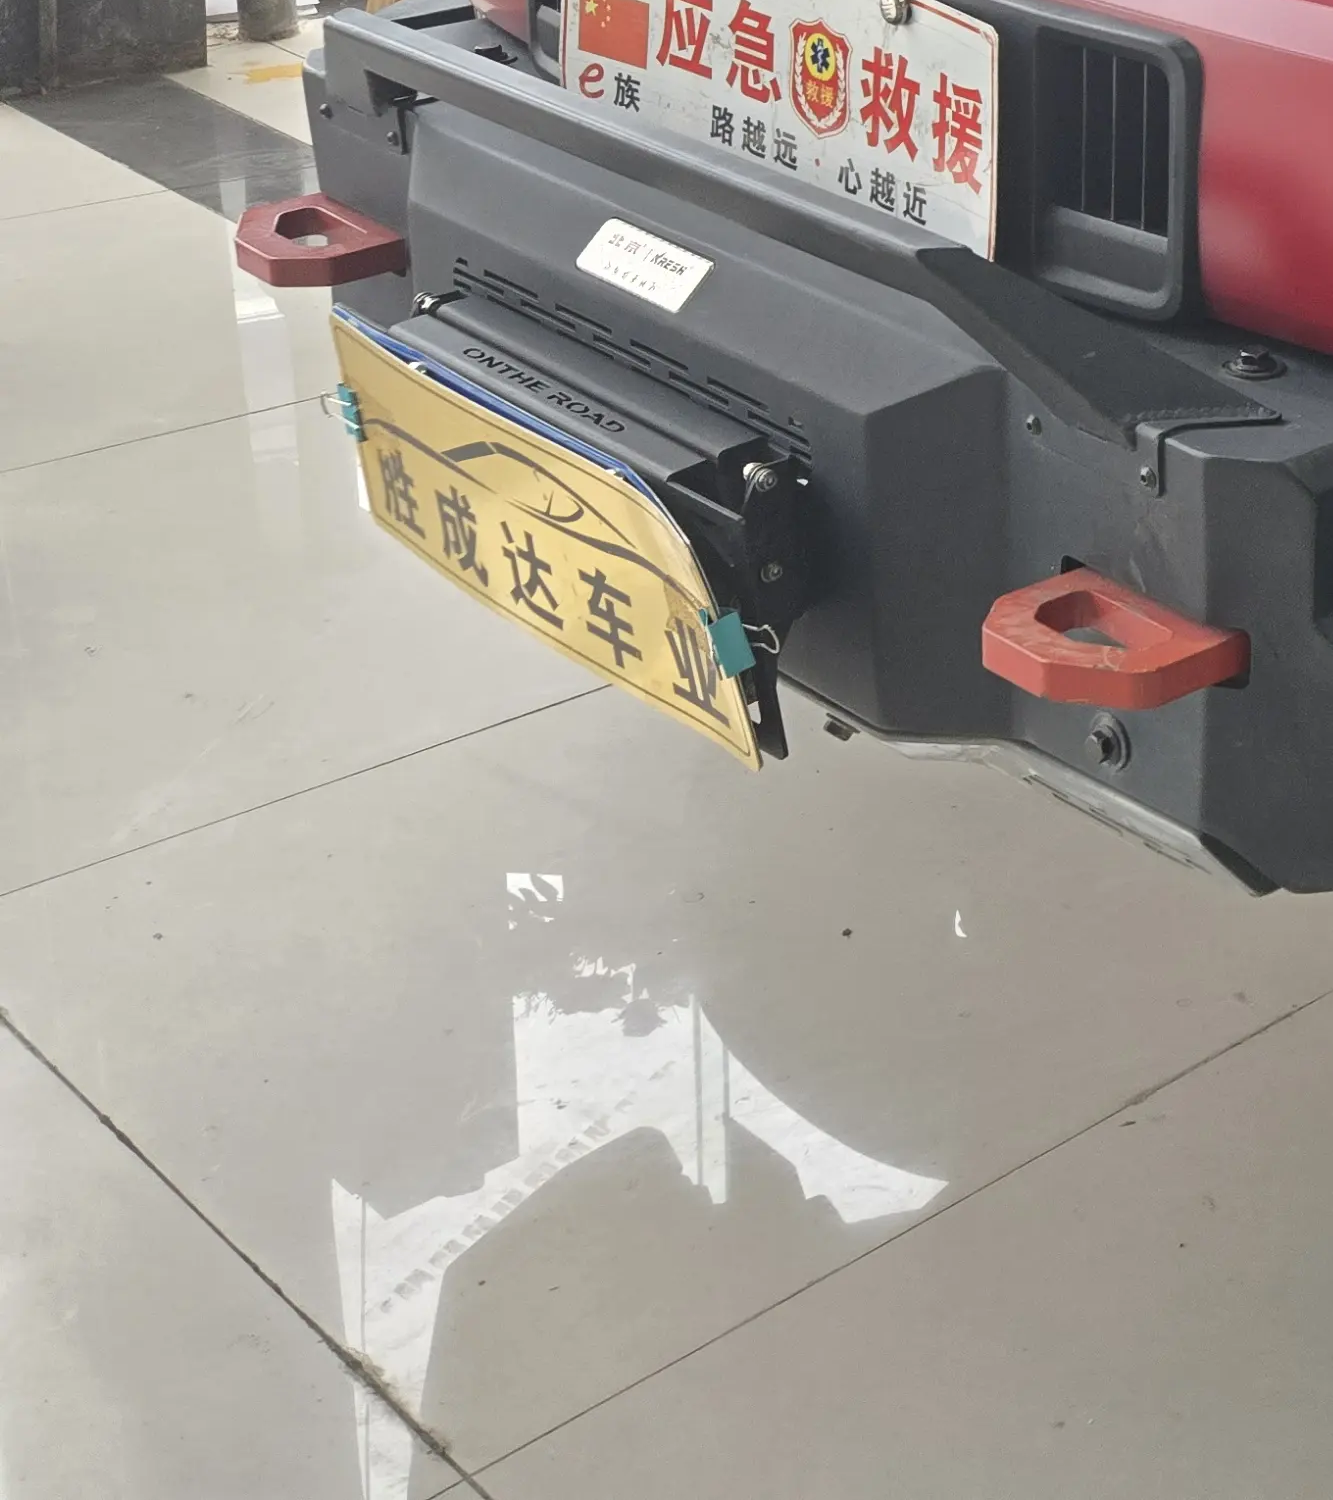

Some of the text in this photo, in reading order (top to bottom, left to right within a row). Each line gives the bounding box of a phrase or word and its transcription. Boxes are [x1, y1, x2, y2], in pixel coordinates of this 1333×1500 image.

[578, 62, 642, 113] e族
[859, 46, 985, 195] 救援
[547, 391, 625, 433] ROAD
[376, 446, 732, 729] 胜成达车业
